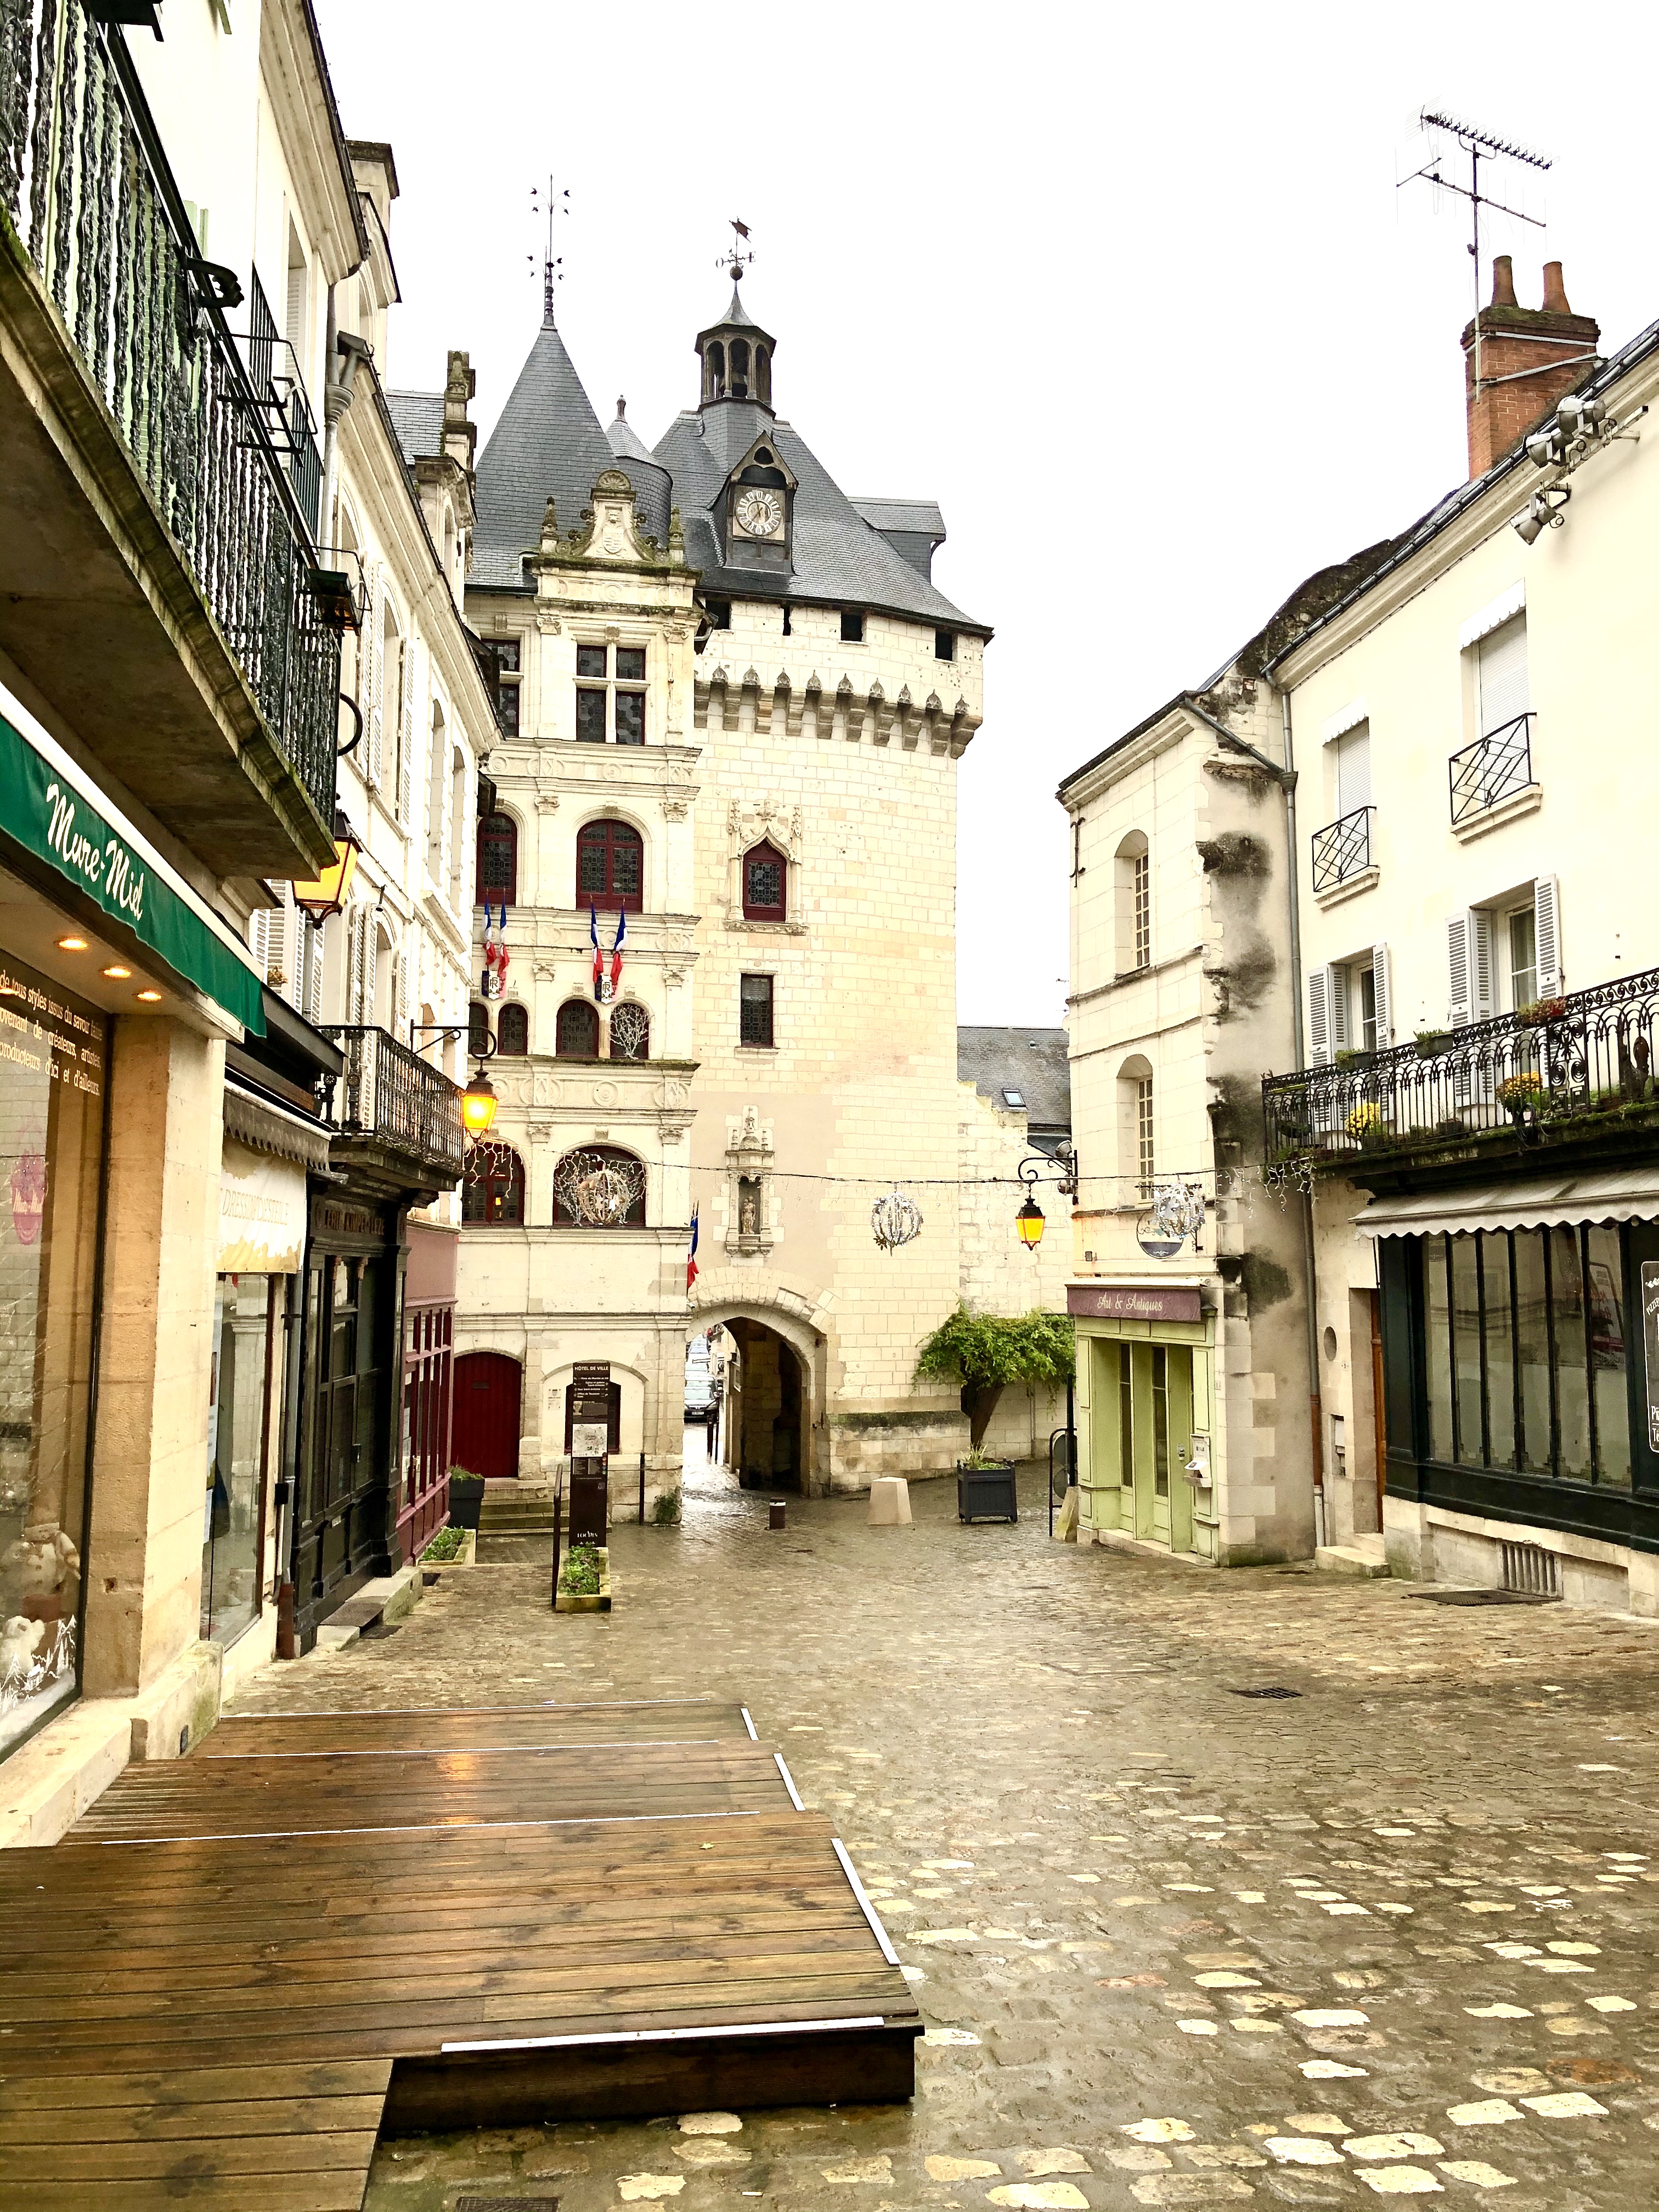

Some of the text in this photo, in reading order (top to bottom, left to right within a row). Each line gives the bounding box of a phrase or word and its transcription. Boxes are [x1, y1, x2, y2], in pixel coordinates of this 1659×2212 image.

[28, 988, 47, 1011] styles
[48, 995, 63, 1019] issus
[64, 1006, 72, 1025] du
[74, 1014, 90, 1034] savoir
[91, 1020, 102, 1041] faire
[33, 1019, 43, 1040] de
[48, 1030, 77, 1060] créateurs,
[81, 1047, 101, 1071] artistes,
[45, 1056, 59, 1079] d'ici
[63, 1068, 70, 1084] et
[74, 1069, 100, 1096] d'ailleurs.
[1097, 1291, 1163, 1317] Art & Antiques
